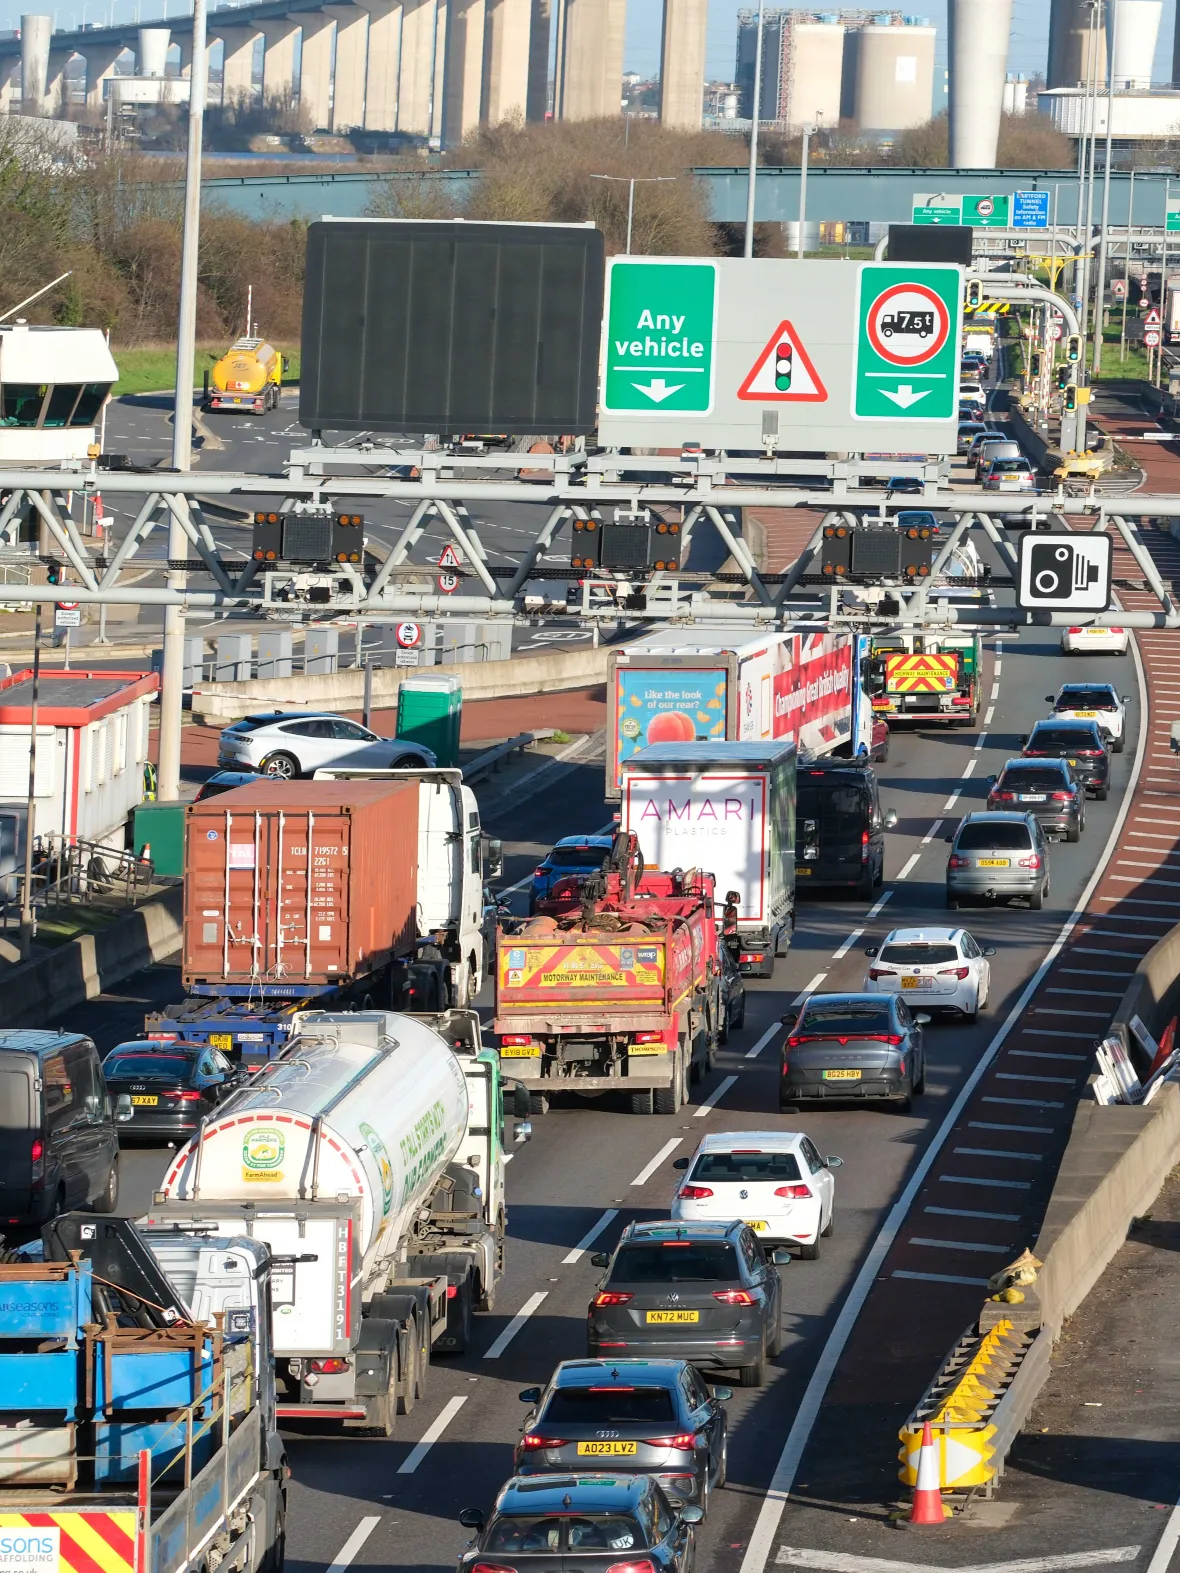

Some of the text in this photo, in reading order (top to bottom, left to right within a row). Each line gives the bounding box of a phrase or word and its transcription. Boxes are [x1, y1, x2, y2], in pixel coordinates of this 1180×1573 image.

[637, 309, 686, 334] Any
[615, 337, 704, 358] vehicle
[444, 576, 454, 585] 15
[640, 798, 754, 820] AMARI
[315, 847, 338, 855] 719572
[638, 952, 656, 960] wrap
[579, 973, 623, 981] MAINTENANCE
[651, 1313, 674, 1321] KN72
[614, 1444, 634, 1452] LVZ
[614, 1537, 633, 1548] UK
